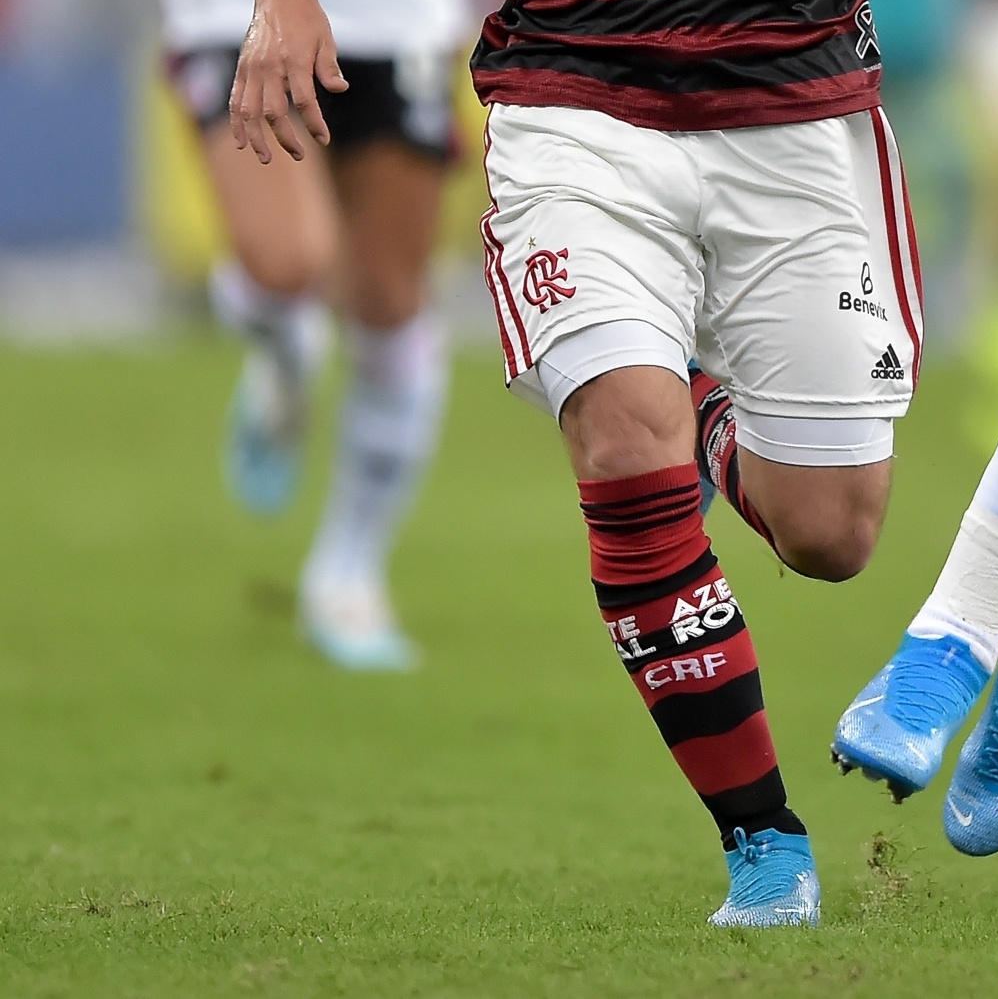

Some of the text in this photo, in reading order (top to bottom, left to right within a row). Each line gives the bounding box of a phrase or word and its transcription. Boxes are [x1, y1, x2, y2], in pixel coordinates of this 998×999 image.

[838, 291, 889, 322] Benevix
[870, 368, 904, 380] adidas
[644, 652, 727, 690] CRF
